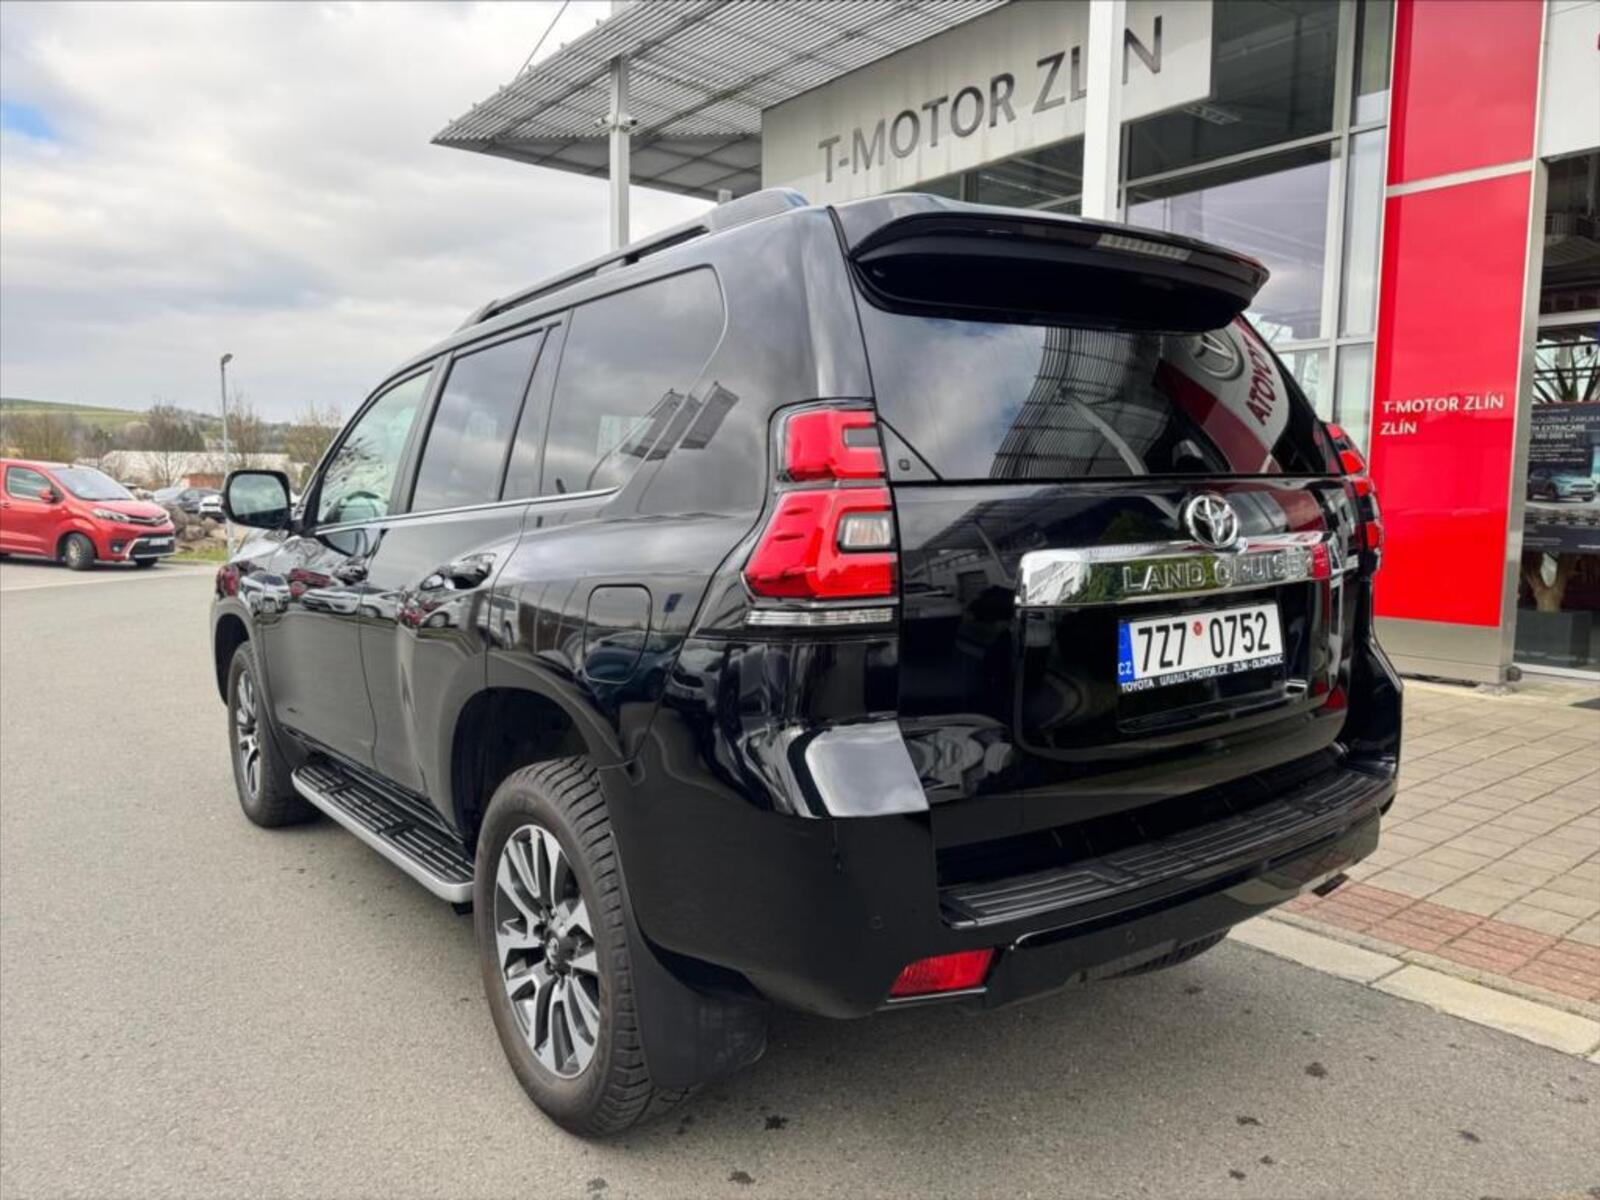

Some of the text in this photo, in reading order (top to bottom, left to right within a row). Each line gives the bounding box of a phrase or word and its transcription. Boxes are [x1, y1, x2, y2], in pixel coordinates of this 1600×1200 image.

[818, 15, 1162, 183] T-MOTOR ZLN
[1382, 390, 1505, 414] T-MOTOR ZLÍN
[1379, 418, 1418, 436] ZLÍN
[1123, 562, 1206, 593] LAND
[1138, 611, 1271, 673] 7Z7 0752
[1118, 661, 1132, 676] CZ
[1121, 679, 1155, 694] TOYOTA
